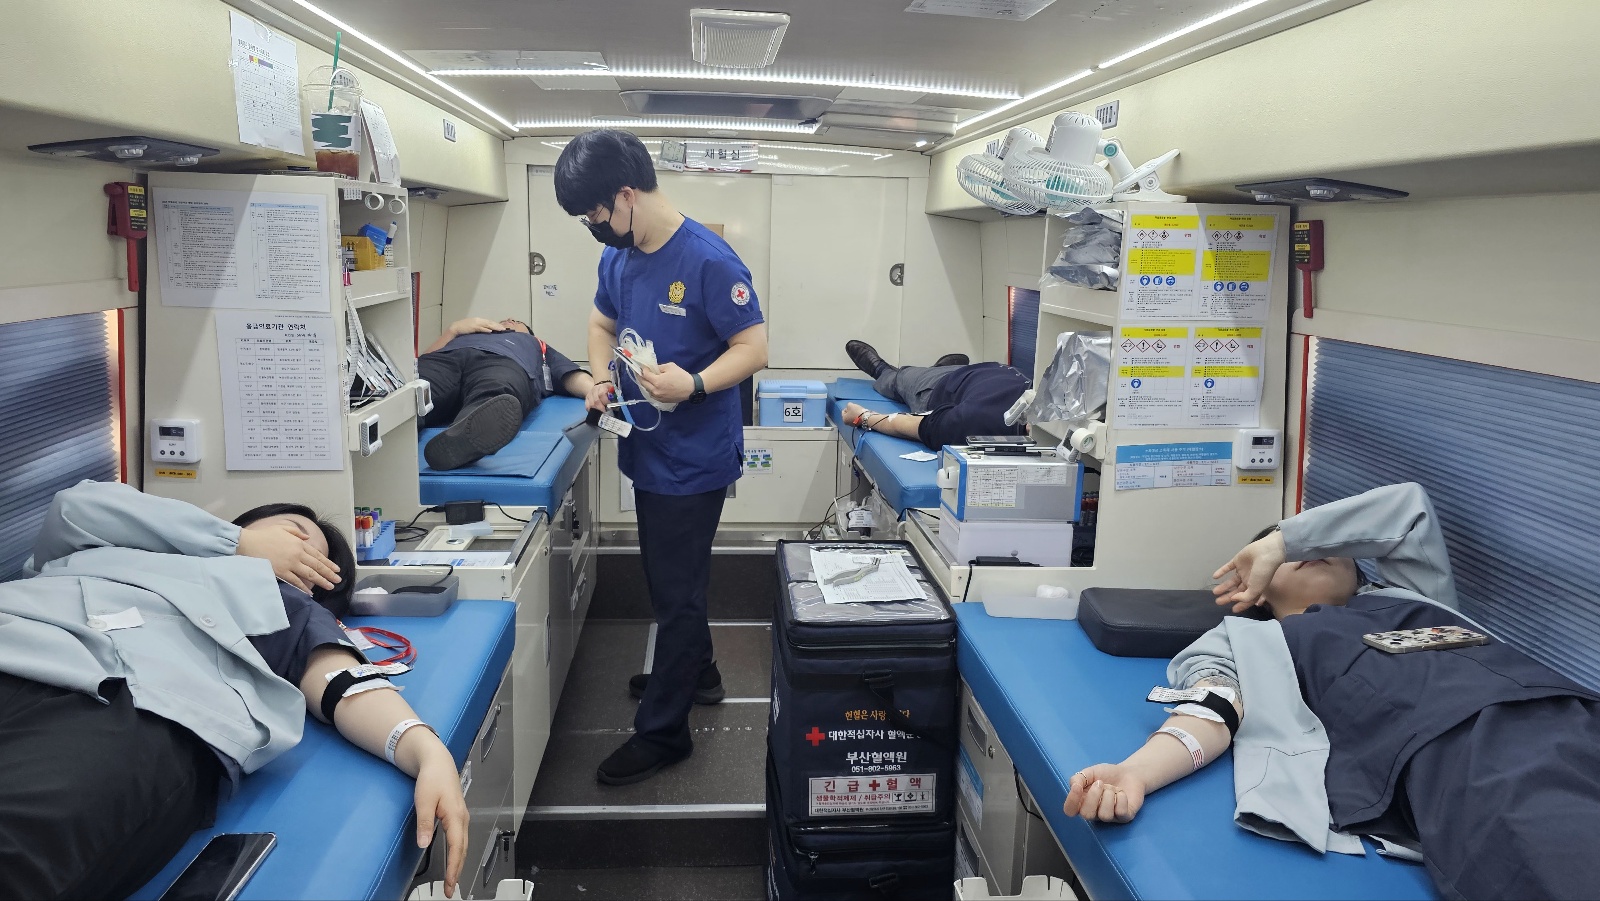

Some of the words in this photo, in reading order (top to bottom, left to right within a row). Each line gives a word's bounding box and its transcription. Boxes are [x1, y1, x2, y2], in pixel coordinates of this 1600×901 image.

[705, 149, 739, 160] 채혈실
[246, 323, 284, 331] 응급의료기관
[784, 406, 802, 417] 6호
[845, 709, 868, 720] 헌혈은
[828, 730, 884, 740] 대한적십자사
[846, 752, 907, 764] 부산혈액원
[851, 765, 901, 773] 051-802-5963
[864, 793, 891, 801] 취급주의
